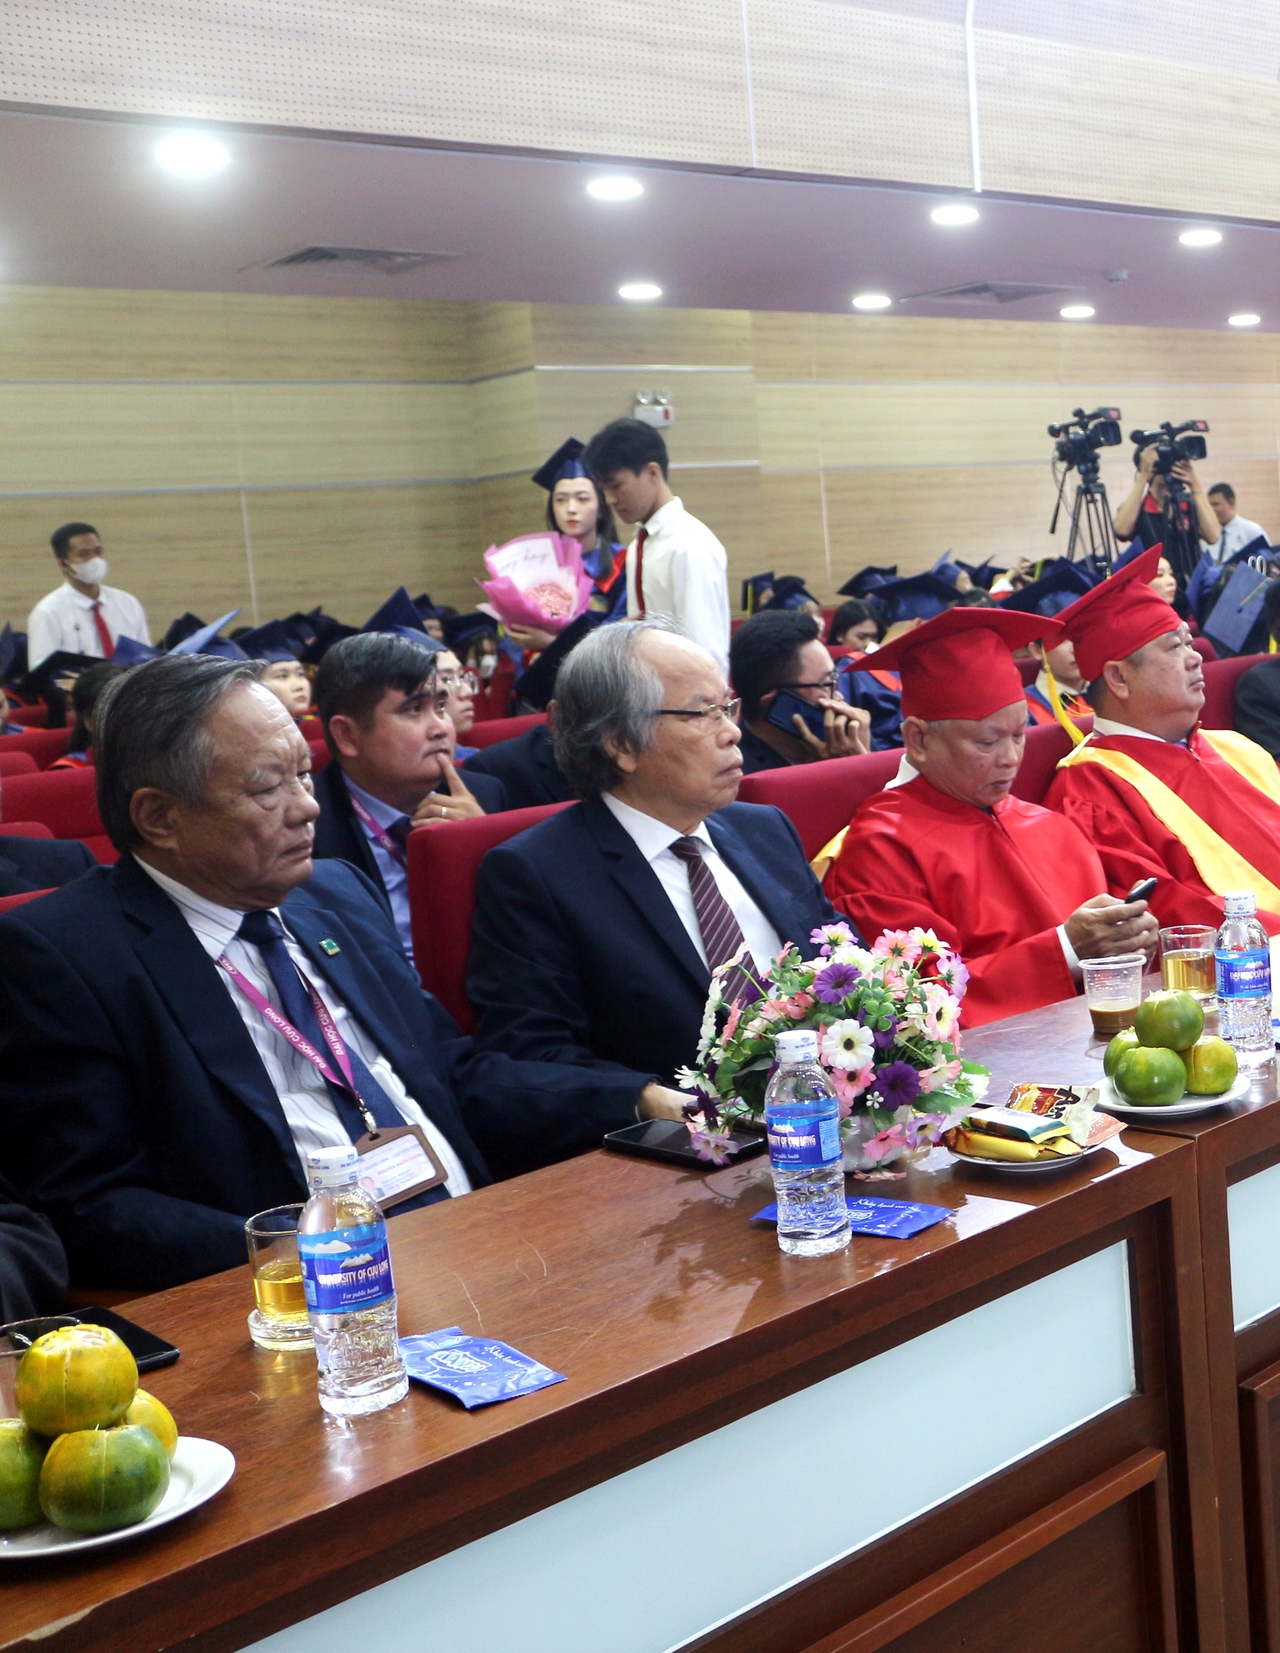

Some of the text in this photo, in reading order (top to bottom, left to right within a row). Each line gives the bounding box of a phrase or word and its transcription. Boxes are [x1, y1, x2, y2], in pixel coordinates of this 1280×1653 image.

[263, 1007, 286, 1028] LONG
[324, 1026, 338, 1043] HỌC
[297, 1039, 316, 1058] HỌC
[800, 1134, 816, 1147] LONG
[318, 1259, 388, 1286] UNIVERSITY OF CUU LONG
[351, 1289, 367, 1299] public
[367, 1285, 380, 1295] health
